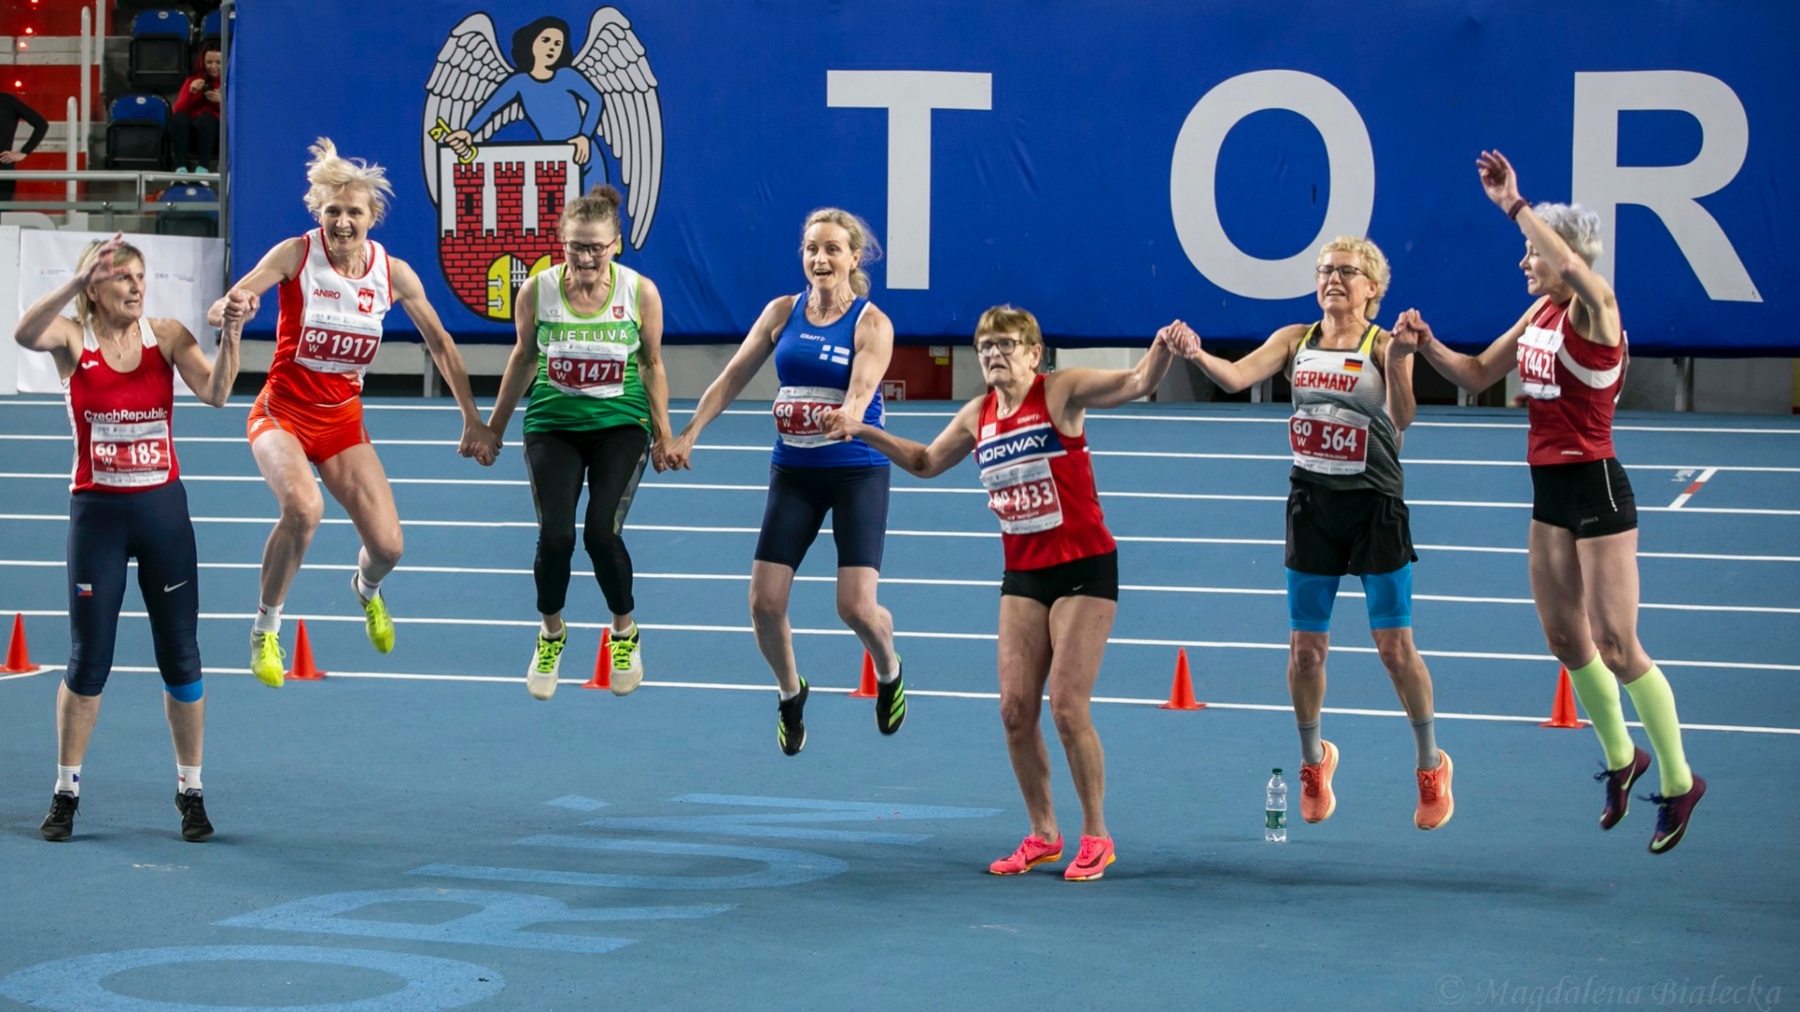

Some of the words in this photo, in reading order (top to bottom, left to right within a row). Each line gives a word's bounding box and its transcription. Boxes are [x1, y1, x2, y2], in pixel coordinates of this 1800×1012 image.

[313, 288, 341, 299] ANIRO
[549, 329, 629, 342] LIETUVA
[305, 330, 328, 344] 60
[331, 334, 377, 358] 1917
[308, 343, 320, 353] W
[551, 359, 573, 372] 60
[577, 362, 620, 382] 1471
[1525, 350, 1551, 379] 1442
[556, 371, 567, 380] W
[1294, 370, 1359, 392] GERMANY
[84, 408, 168, 422] CzechRepublic
[775, 403, 793, 417] 60
[782, 418, 791, 428] W
[1292, 420, 1312, 436] 60
[1321, 425, 1357, 452] 564
[1296, 436, 1306, 446] W
[95, 443, 117, 457] 60
[128, 442, 161, 465] 185
[979, 434, 1049, 465] NORWAY
[101, 457, 113, 466] W
